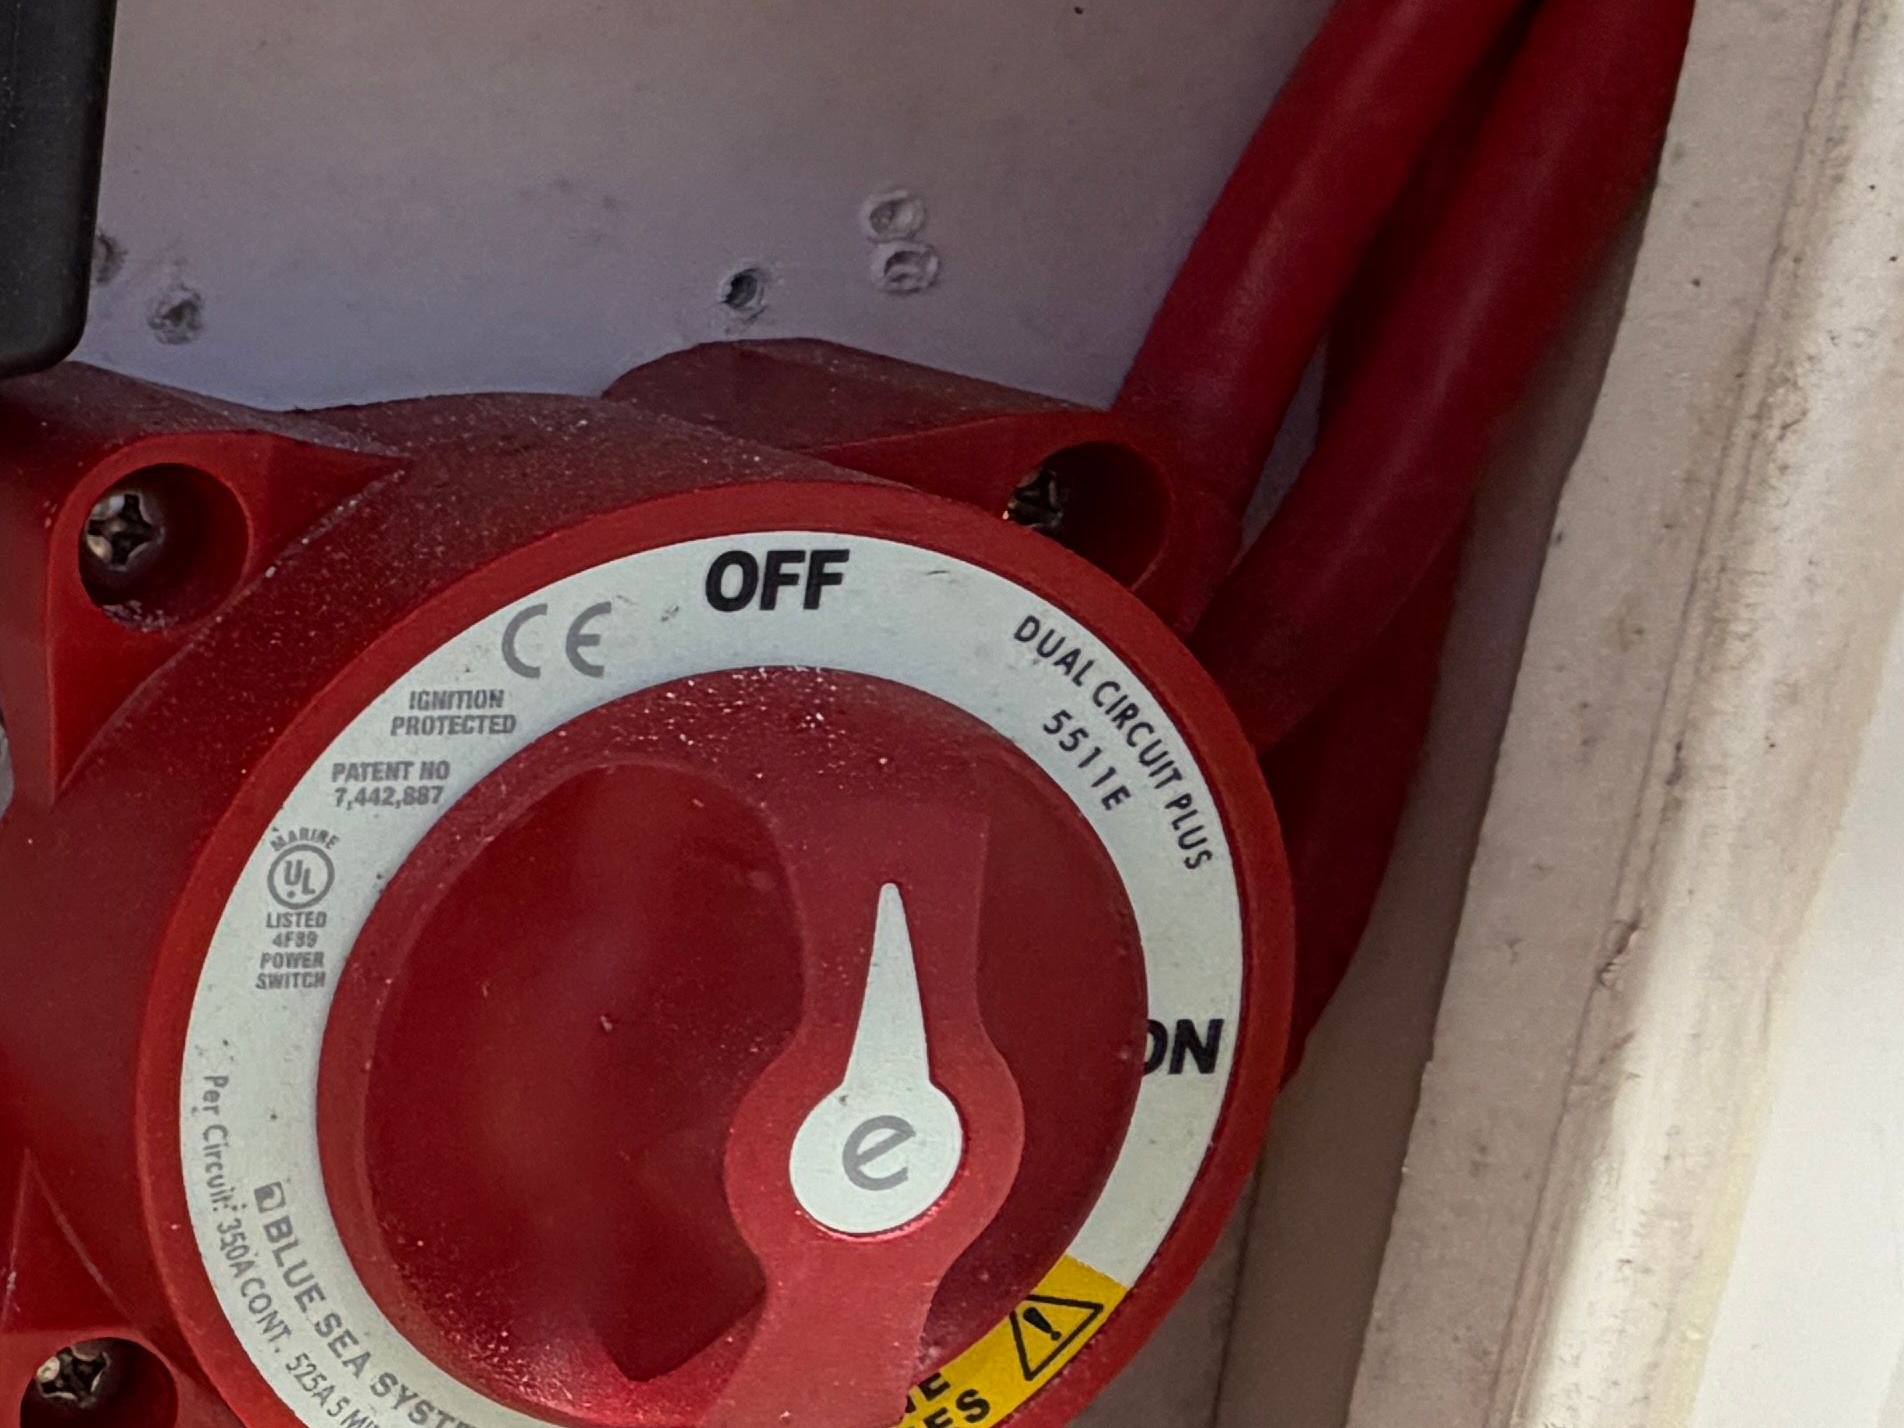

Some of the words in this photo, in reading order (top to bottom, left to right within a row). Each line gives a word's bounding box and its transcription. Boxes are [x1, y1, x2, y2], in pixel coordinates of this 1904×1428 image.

[704, 549, 851, 612] OFF
[408, 688, 505, 711] IGNITION
[390, 714, 517, 737] PROTECTED
[1013, 615, 1095, 688] DUAL
[1092, 680, 1183, 790] CIRCUIT
[1164, 792, 1213, 870] PLUS
[331, 760, 414, 783] PATENT
[1043, 709, 1132, 811] 5511E
[265, 910, 328, 929] LISTED
[259, 950, 325, 970] POWER
[255, 971, 326, 991] SWITCH
[201, 1073, 229, 1117] Per
[262, 1214, 327, 1314] BLUE
[314, 1312, 373, 1380] SEA
